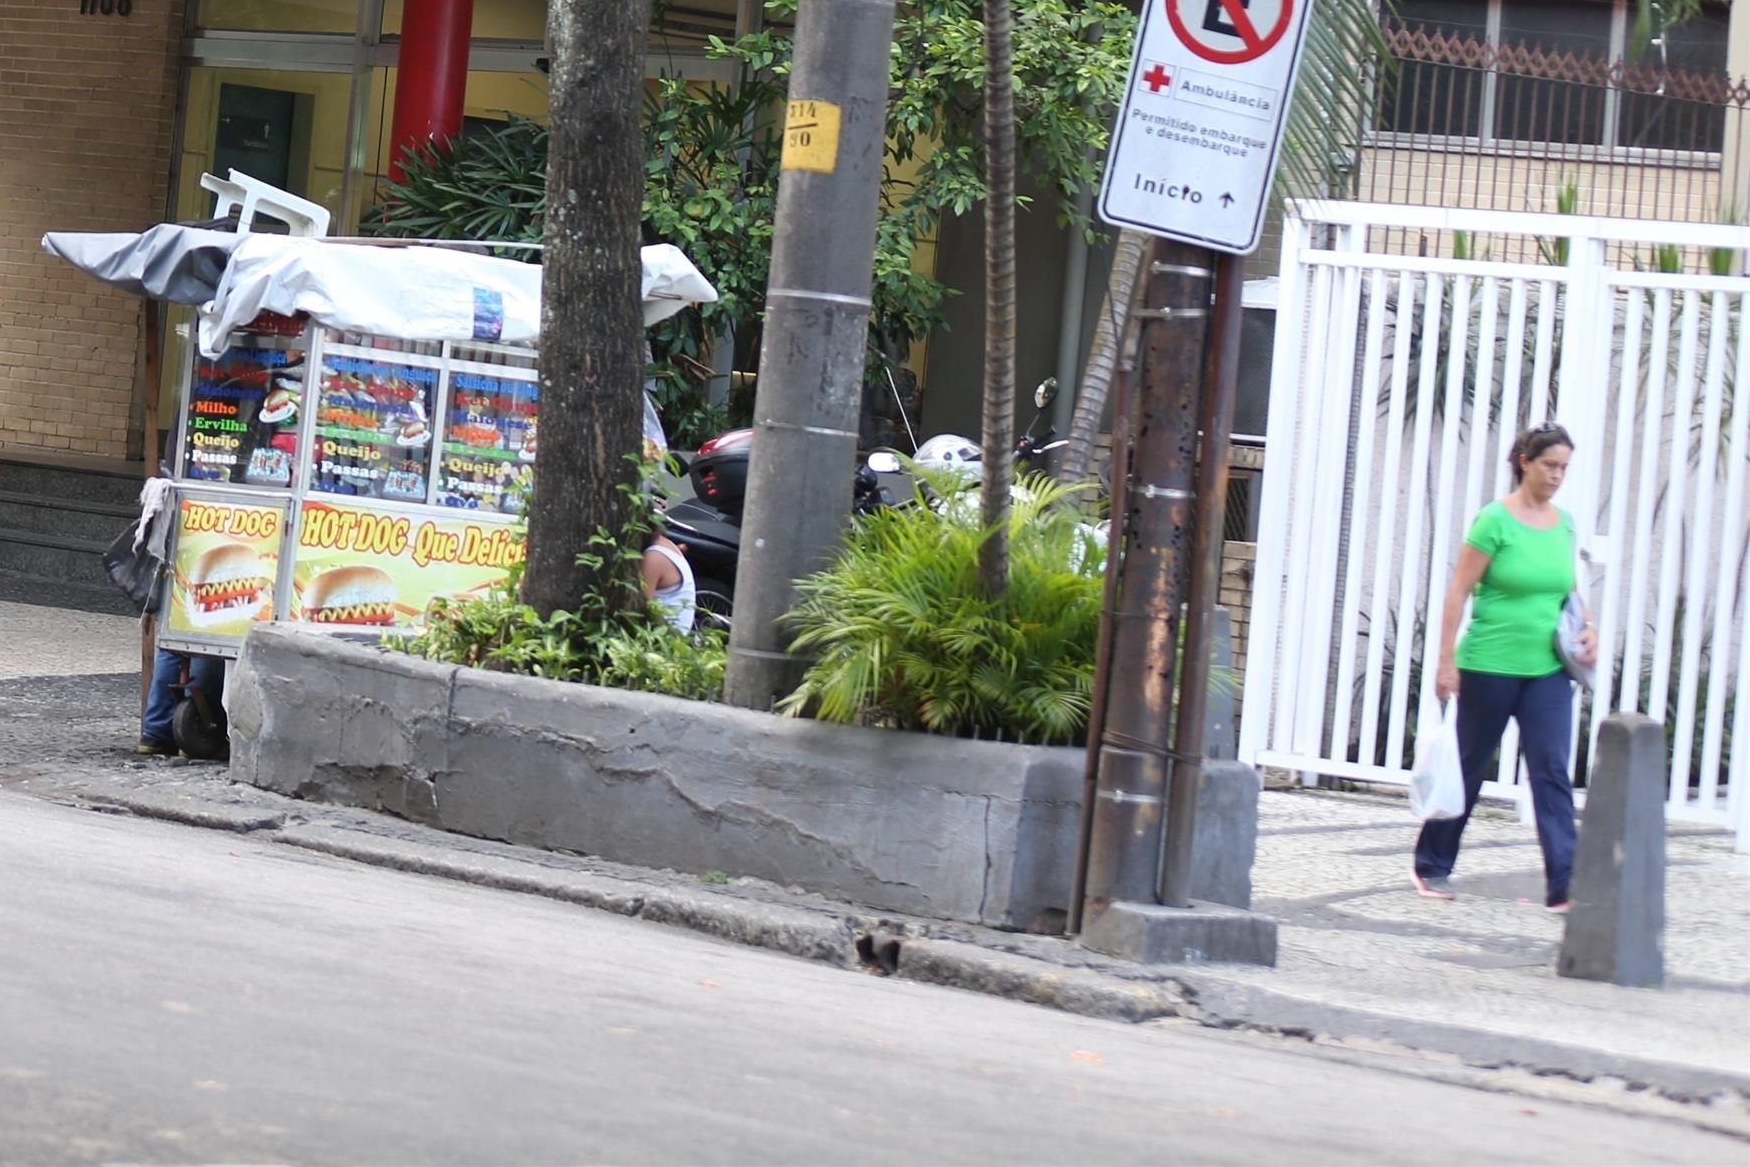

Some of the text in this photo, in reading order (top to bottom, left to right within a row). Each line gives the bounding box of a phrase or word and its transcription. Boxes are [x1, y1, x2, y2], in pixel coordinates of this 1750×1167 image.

[1132, 107, 1268, 150] Permitido embarque
[1145, 125, 1249, 158] e desembarque
[1134, 172, 1203, 204] Início
[195, 400, 239, 415] Milho
[194, 416, 249, 433] Ervilha
[192, 432, 240, 449] Queijo
[322, 440, 382, 461] Queijo
[191, 449, 238, 466] Passas
[449, 457, 506, 475] Queijo
[320, 460, 379, 480] Passas
[446, 476, 504, 495] Passas
[184, 504, 277, 538] HOT DOG
[301, 508, 356, 550] HOT
[351, 513, 409, 555] DOG
[413, 521, 460, 566] Que
